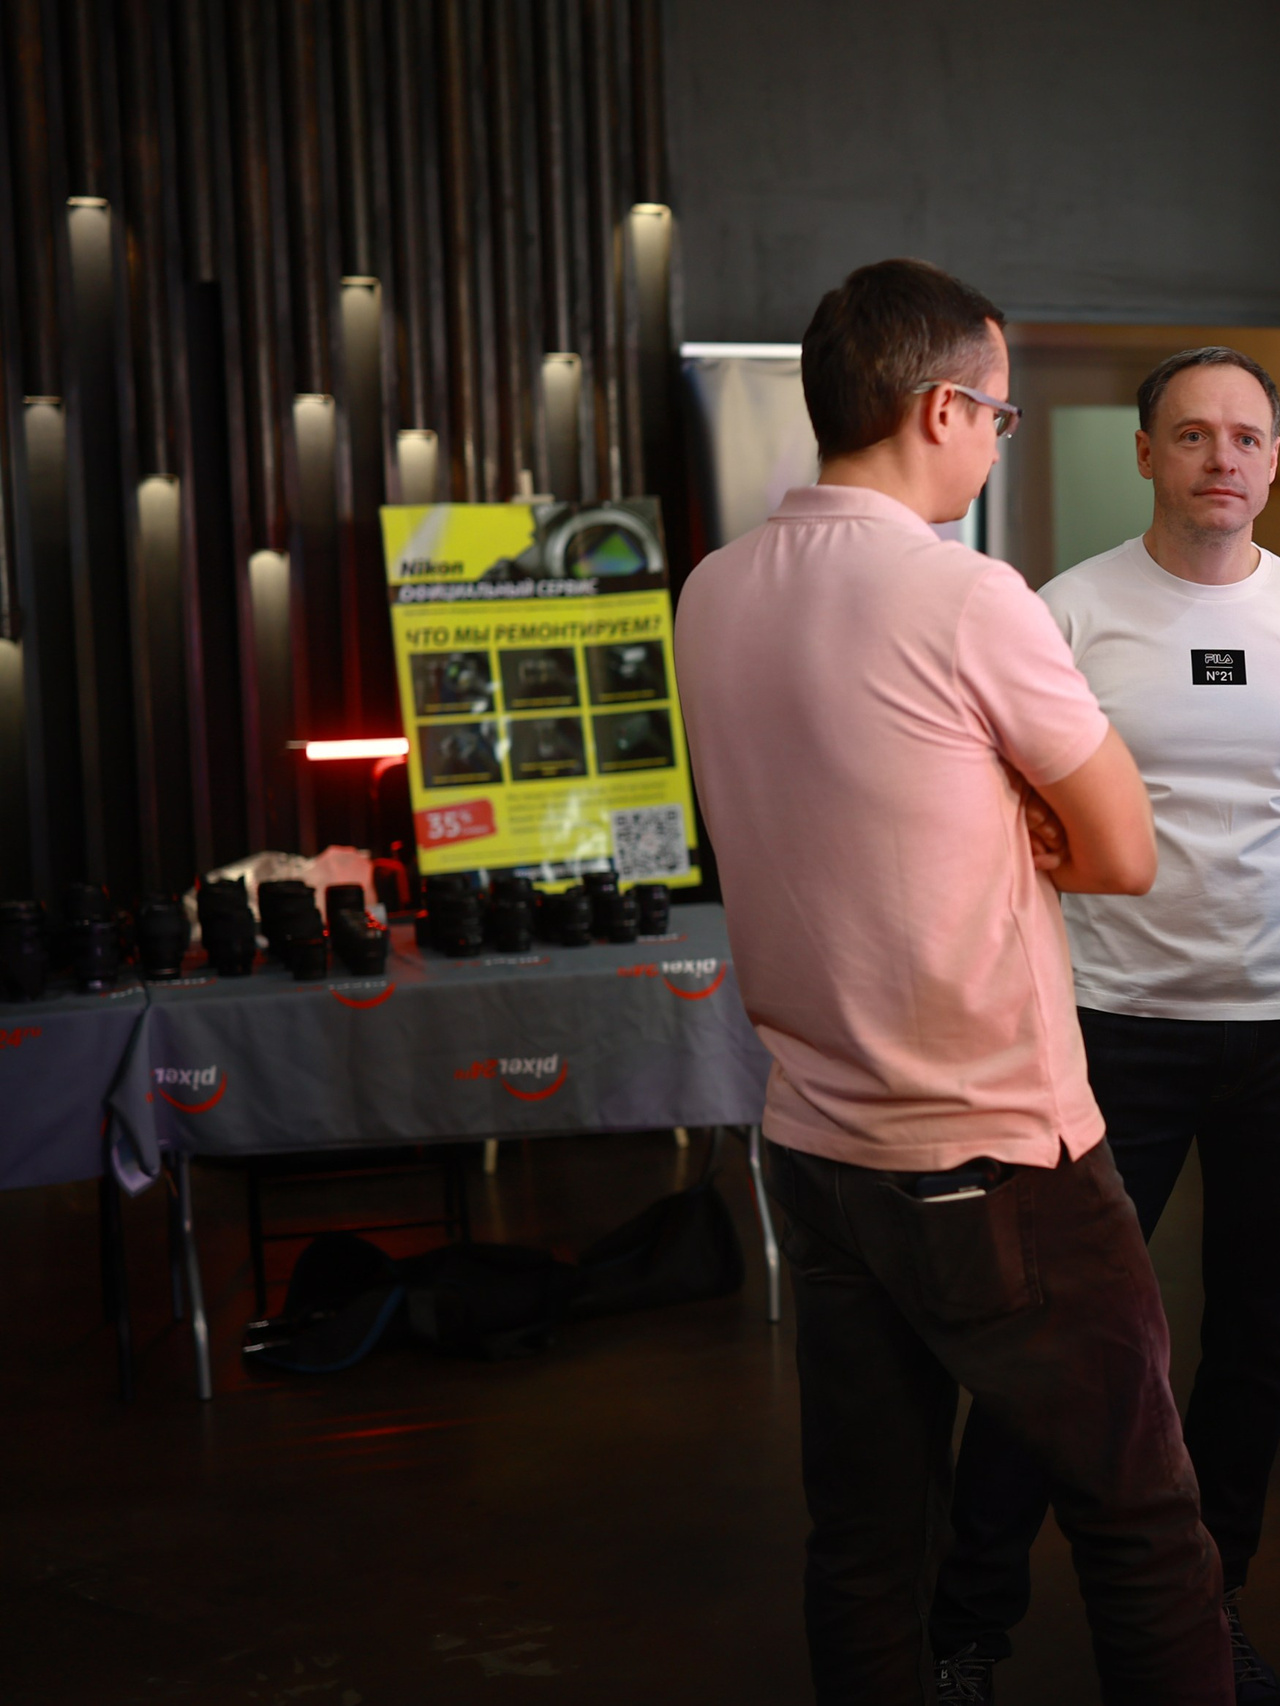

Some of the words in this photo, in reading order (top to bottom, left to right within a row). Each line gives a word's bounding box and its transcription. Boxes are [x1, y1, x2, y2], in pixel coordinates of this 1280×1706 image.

[401, 559, 464, 577] Nikon
[405, 626, 450, 648] ЧТО
[453, 624, 491, 645] МЫ
[494, 614, 662, 643] РЕМОНТИРУЕМ?
[1204, 653, 1234, 665] FILA
